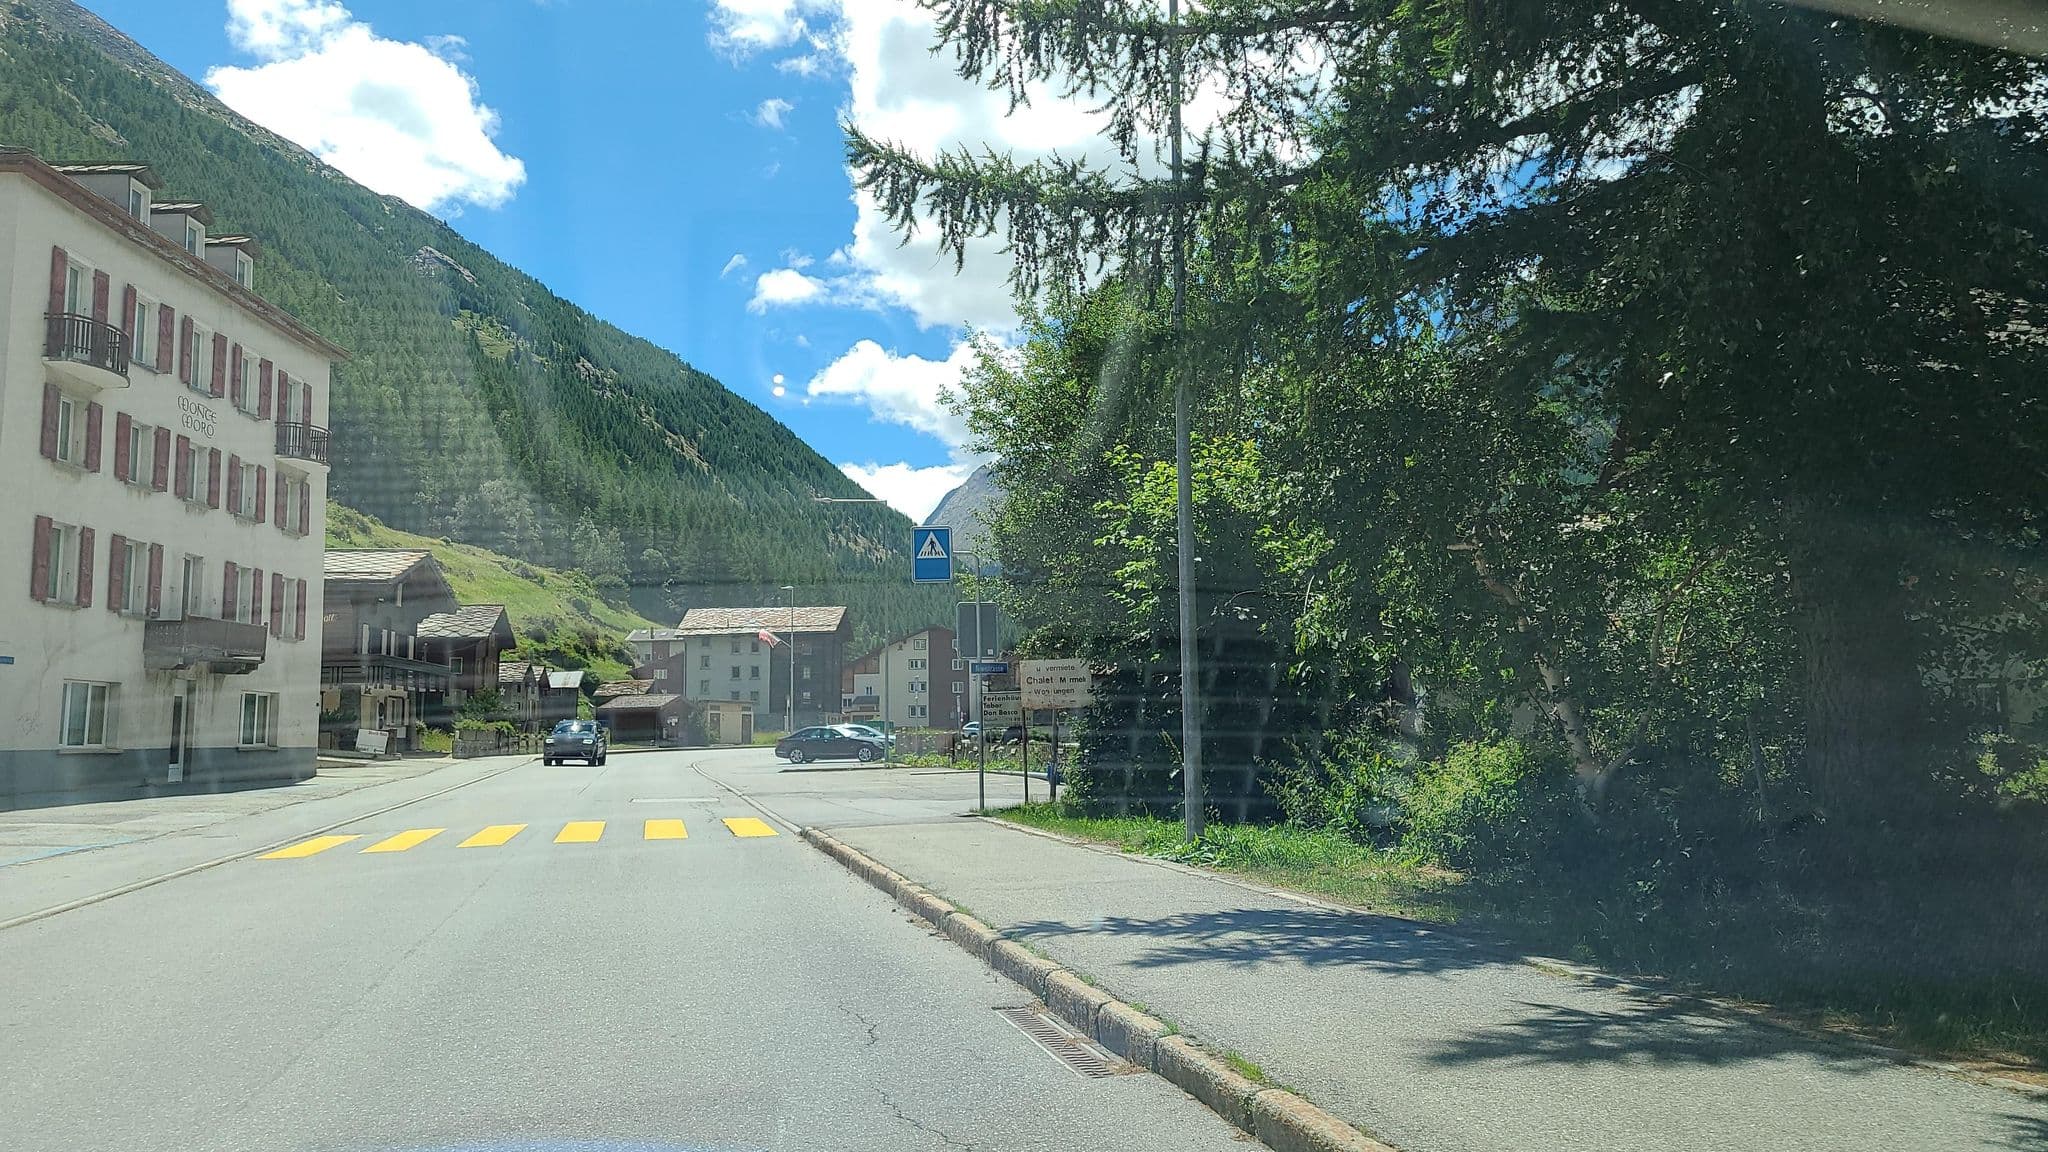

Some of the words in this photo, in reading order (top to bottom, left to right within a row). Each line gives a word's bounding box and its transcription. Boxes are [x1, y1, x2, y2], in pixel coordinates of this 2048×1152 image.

[178, 396, 216, 424] MONTE
[182, 413, 214, 439] MORO
[1026, 676, 1053, 685] Chalet
